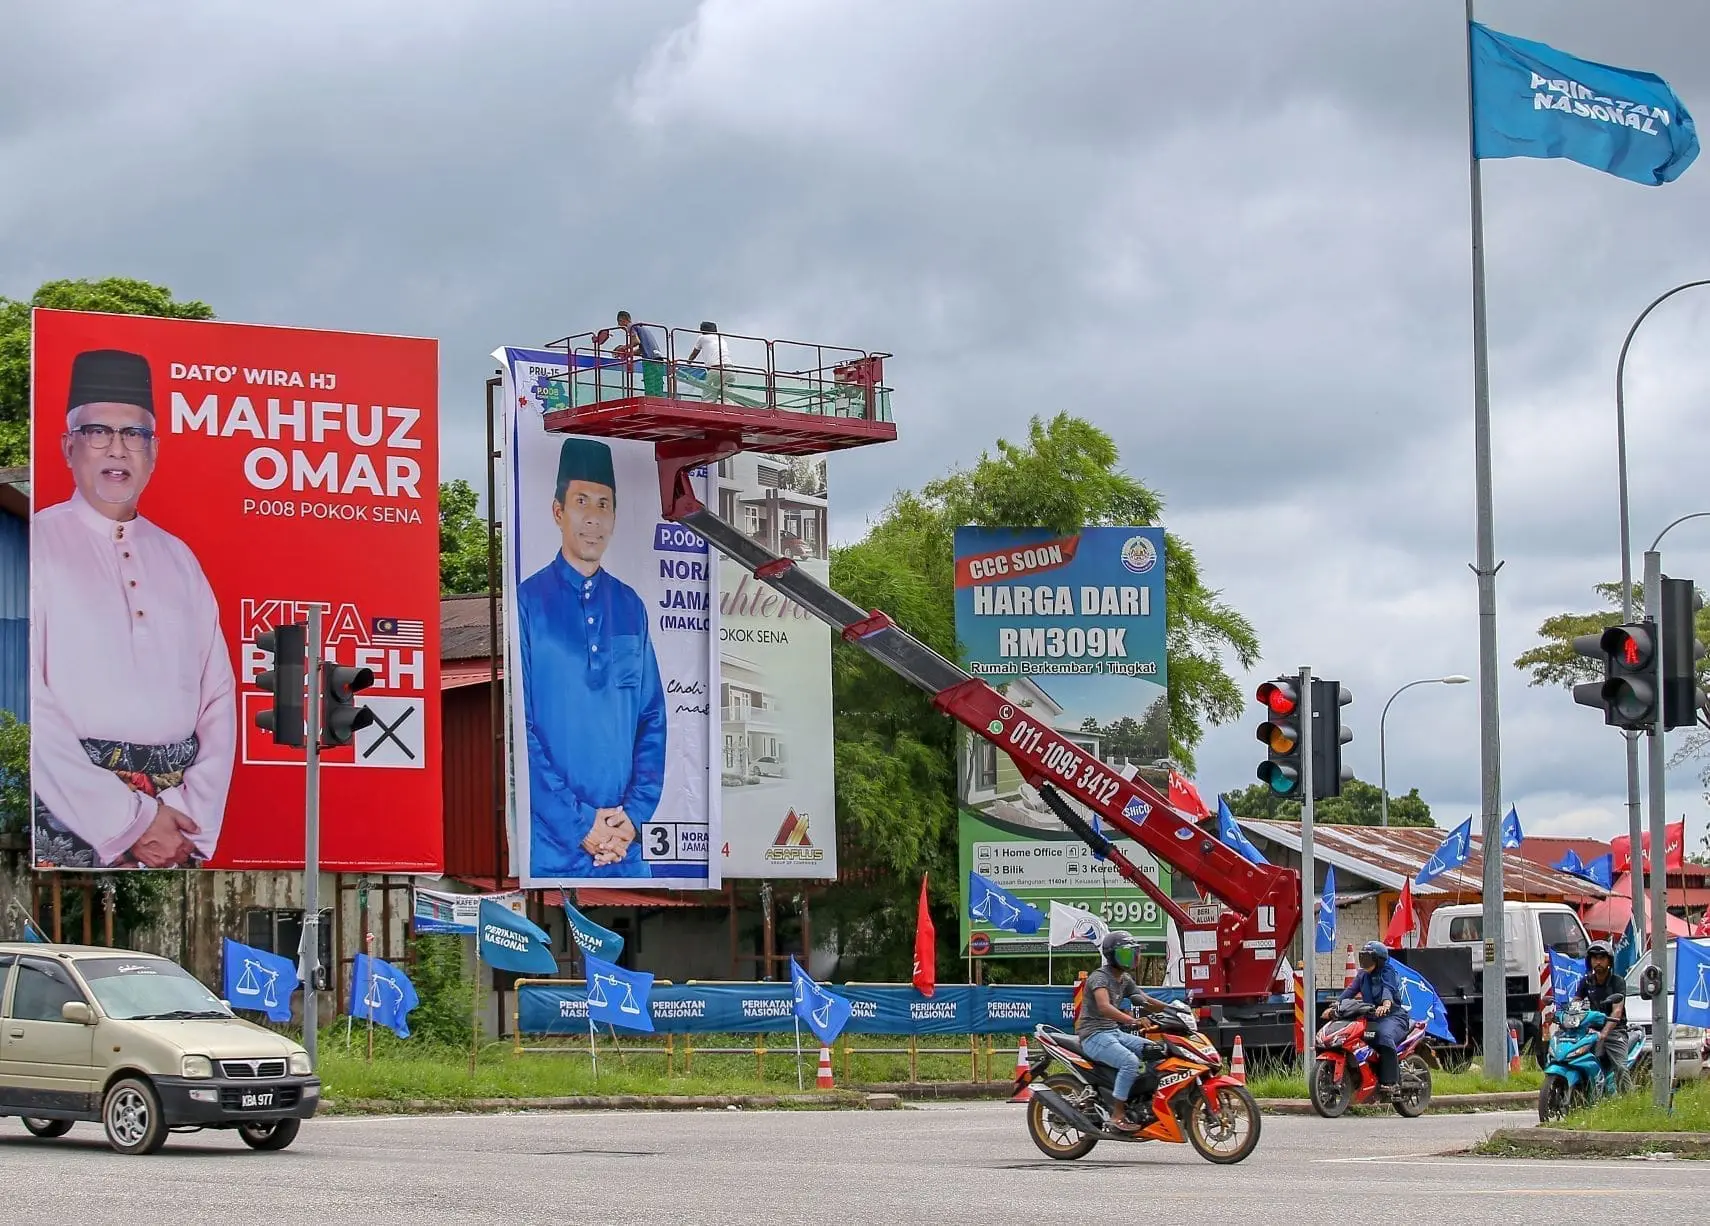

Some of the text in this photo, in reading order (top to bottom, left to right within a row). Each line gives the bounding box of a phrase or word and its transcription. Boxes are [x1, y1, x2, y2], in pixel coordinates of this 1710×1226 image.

[243, 366, 304, 388] WIRA
[309, 372, 336, 390] HJ
[530, 366, 560, 377] PRU-15
[171, 391, 422, 450] MAHFUZ
[243, 446, 422, 499] OMAR
[244, 498, 422, 525] P.008 POKOK SENA
[969, 544, 1063, 580] CCC SOON
[973, 585, 1150, 616] HARGA DARI
[240, 598, 371, 646] KITA
[719, 628, 789, 644] OKOK SENA
[999, 627, 1127, 658] RM309K
[242, 643, 425, 690] BEH
[971, 662, 1157, 677] Rumah Berkembar 1 Tingkat
[1009, 720, 1083, 780] 011-1095
[1076, 765, 1120, 807] 3412
[650, 827, 670, 856] 3
[721, 842, 730, 858] 4
[994, 847, 1063, 857] 1 Home Office
[1081, 848, 1087, 856] 2
[994, 865, 1025, 874] 3 Bilik
[1082, 865, 1087, 873] 3
[1100, 901, 1157, 923] 5998
[653, 1000, 705, 1010] PERIKATAN
[742, 1000, 793, 1009] PERIKATAN
[744, 1007, 792, 1017] NASIONAL
[910, 1002, 957, 1012] PERIKATAN
[987, 1001, 1032, 1011] PERIKATAN
[654, 1008, 704, 1018] NASIONAL
[911, 1009, 956, 1019] NASIONAL
[988, 1009, 1030, 1019] NASIONAL
[258, 1093, 273, 1106] 977
